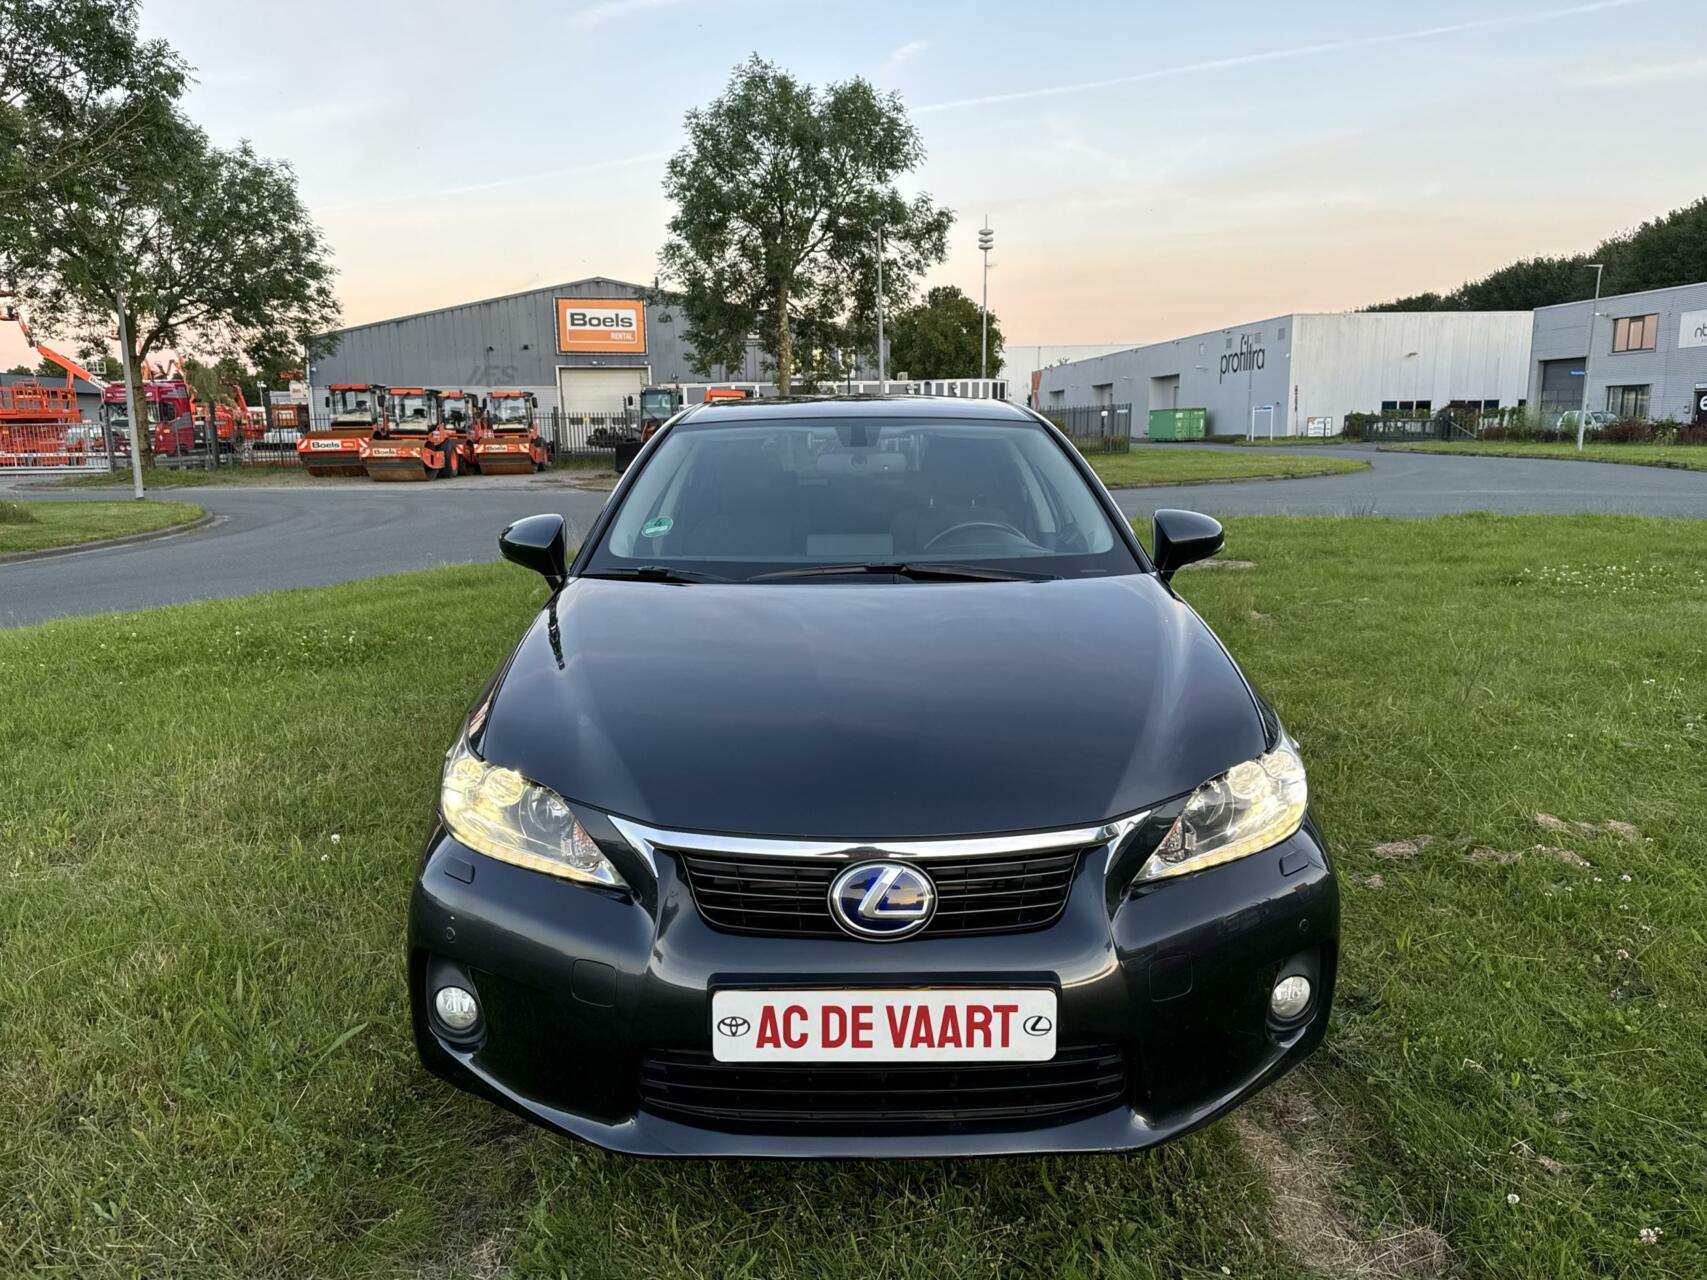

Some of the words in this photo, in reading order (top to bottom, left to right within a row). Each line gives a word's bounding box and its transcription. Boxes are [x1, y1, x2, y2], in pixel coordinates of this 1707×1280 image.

[569, 312, 633, 328] Boels
[609, 332, 634, 340] RENTAL
[1219, 333, 1265, 384] profiltra
[312, 441, 350, 449] Boels
[756, 1005, 808, 1049] AC
[821, 1005, 873, 1048] DE
[885, 1004, 1019, 1048] VAART
